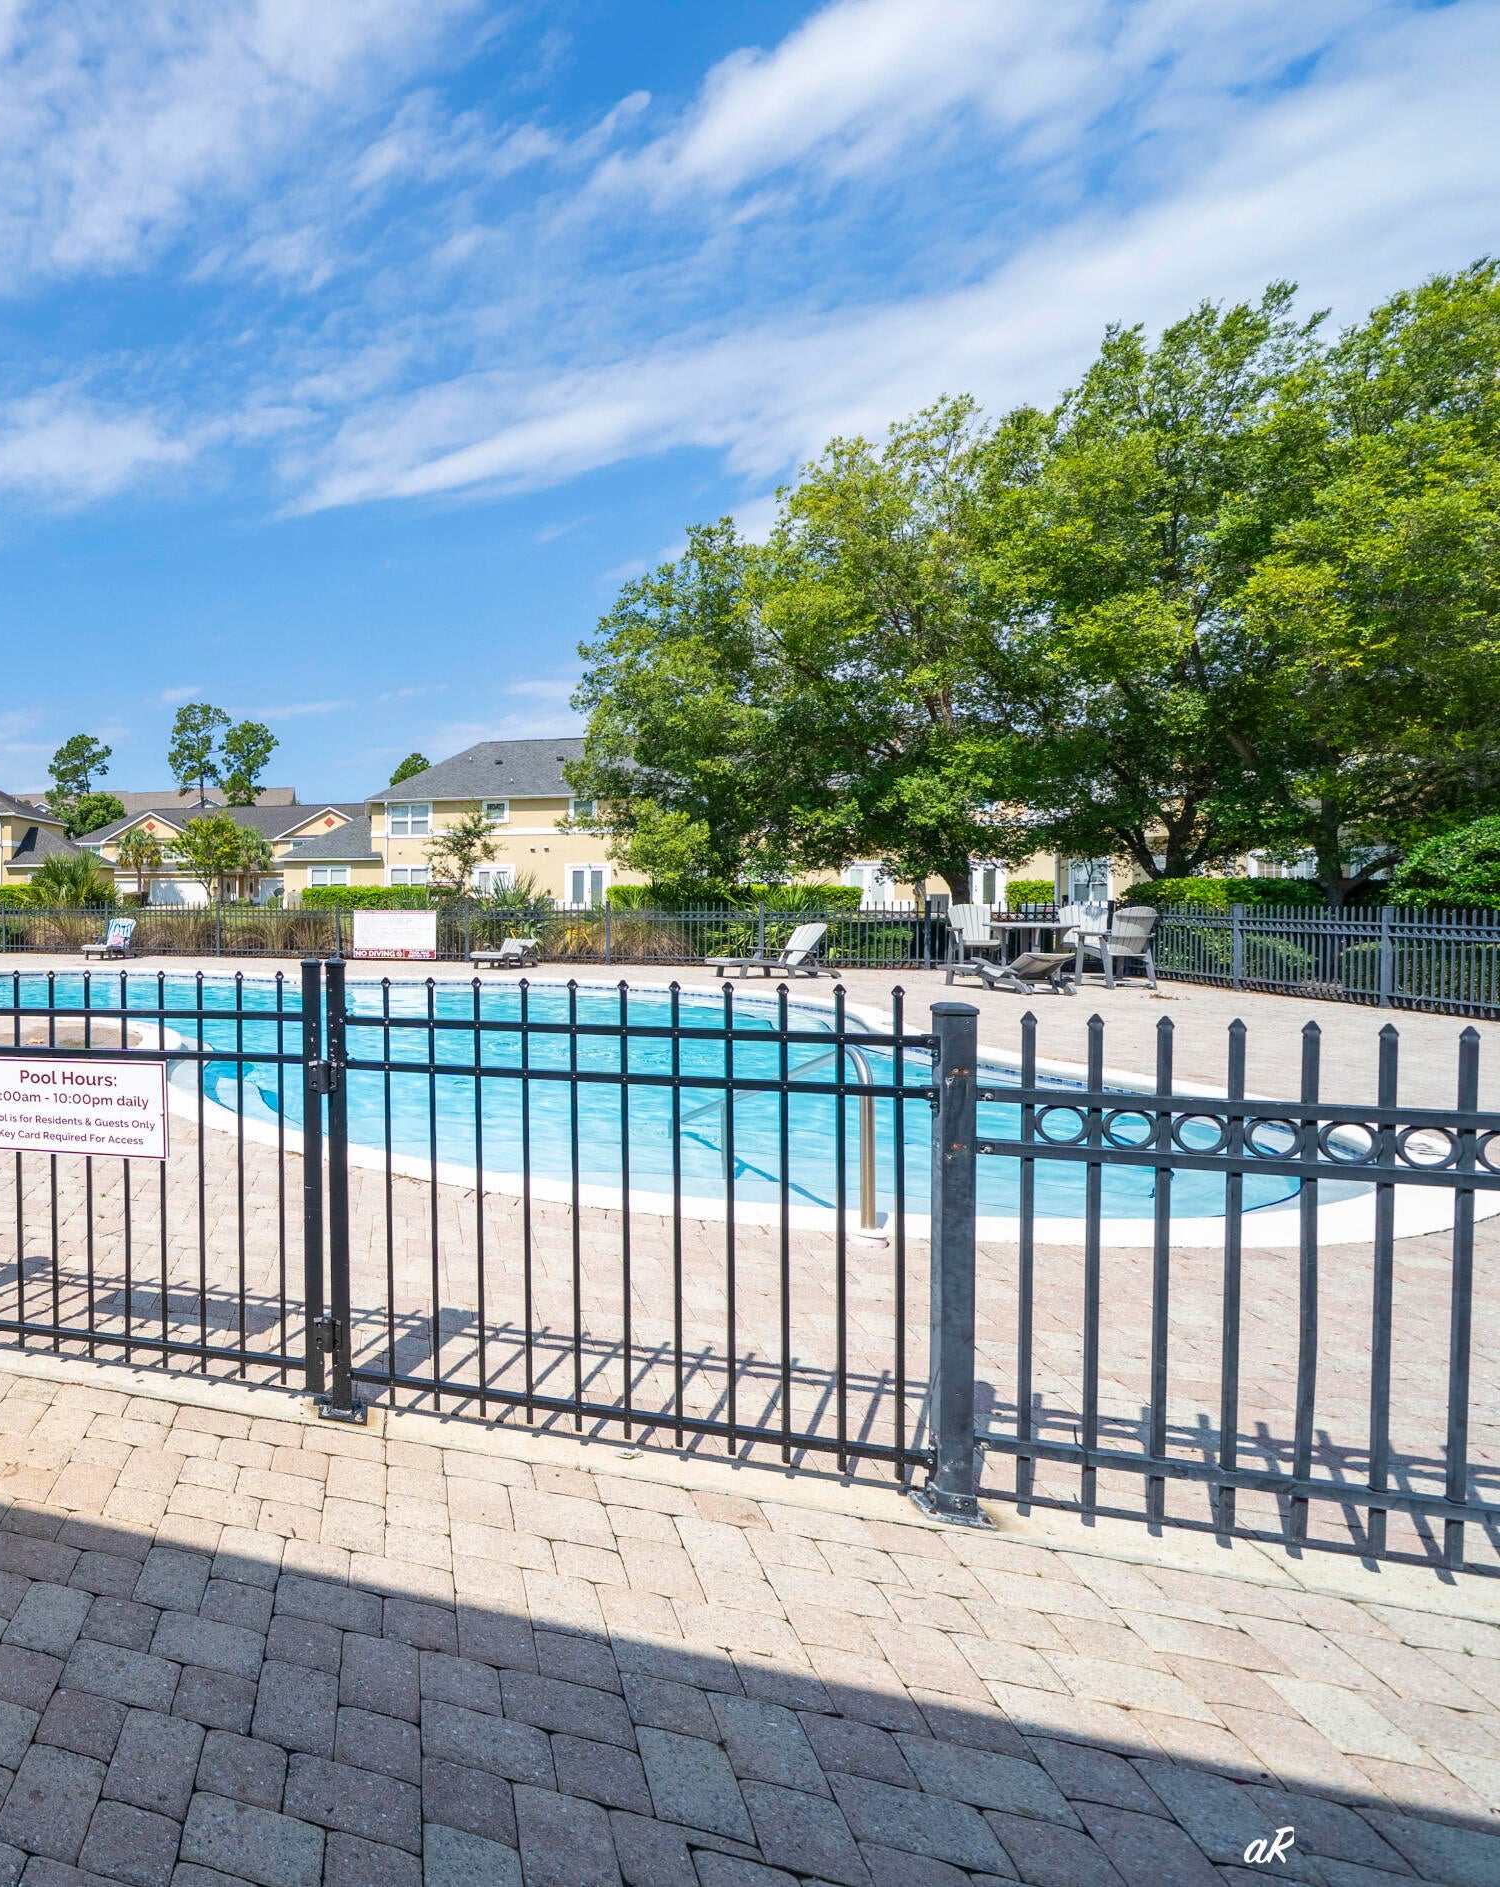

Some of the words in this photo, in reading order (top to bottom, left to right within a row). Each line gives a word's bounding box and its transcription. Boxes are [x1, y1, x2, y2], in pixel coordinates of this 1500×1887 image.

[19, 1069, 58, 1085] Pool
[61, 1070, 117, 1087] Hours:
[52, 1092, 113, 1108] 10:00pm
[115, 1094, 149, 1111] daily
[9, 1113, 18, 1123] is
[18, 1113, 33, 1123] for
[34, 1114, 83, 1126] Residents
[84, 1116, 92, 1126] &
[93, 1117, 130, 1128] Guests
[131, 1119, 156, 1132] Only
[17, 1129, 41, 1139] Card
[42, 1130, 87, 1143] Required
[89, 1133, 106, 1143] For
[107, 1134, 144, 1145] Access
